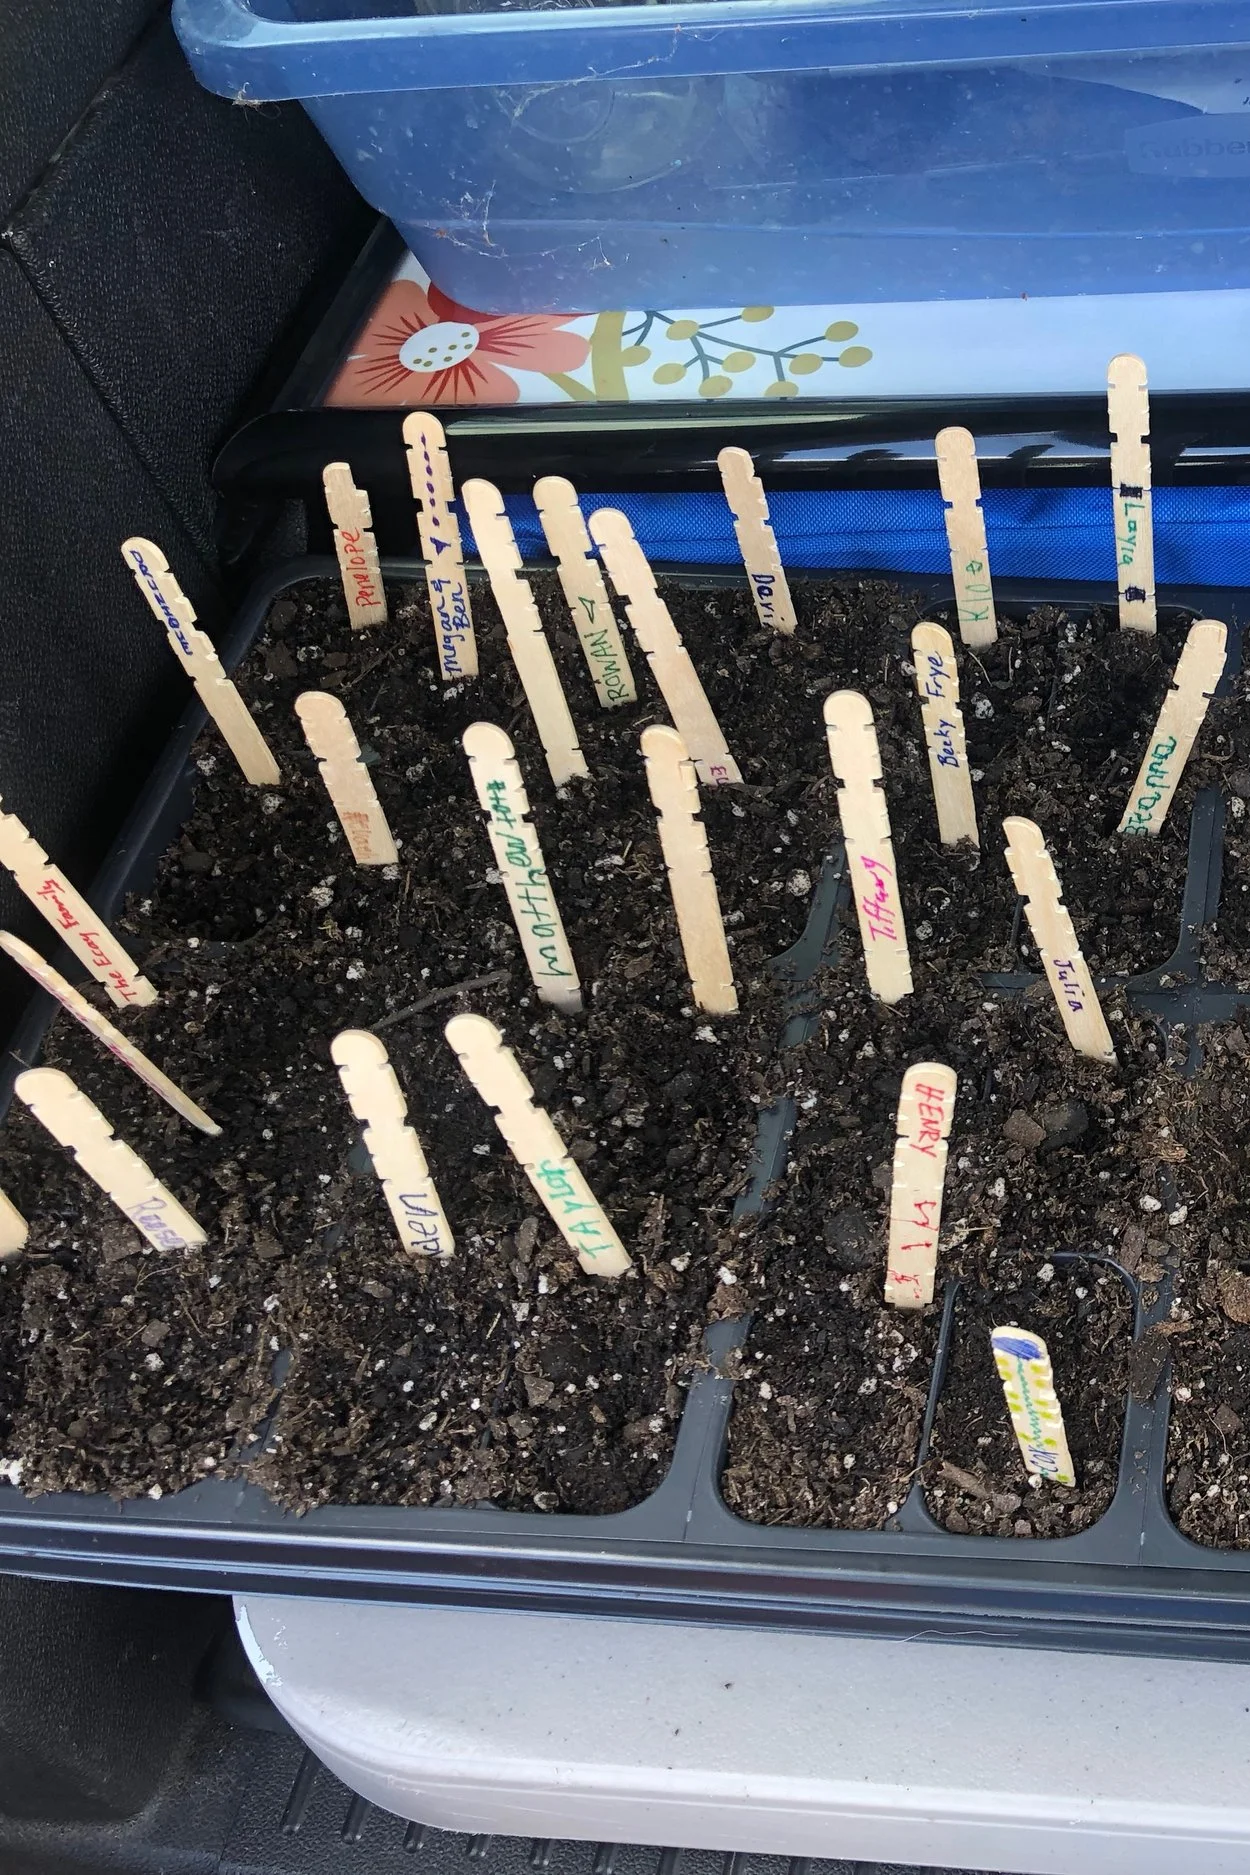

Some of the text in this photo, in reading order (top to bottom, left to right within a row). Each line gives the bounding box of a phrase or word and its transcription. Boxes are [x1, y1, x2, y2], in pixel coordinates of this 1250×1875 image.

[1118, 502, 1144, 567] Layla
[343, 530, 380, 607] Penelope
[448, 581, 469, 630] Ben
[590, 633, 629, 703] ROWAN
[925, 651, 960, 769] Becky Frye
[39, 880, 80, 933] Family
[858, 855, 898, 940] Tiffany
[109, 971, 137, 1002] The
[1052, 958, 1083, 1012] Julia
[908, 1081, 946, 1159] HENRY
